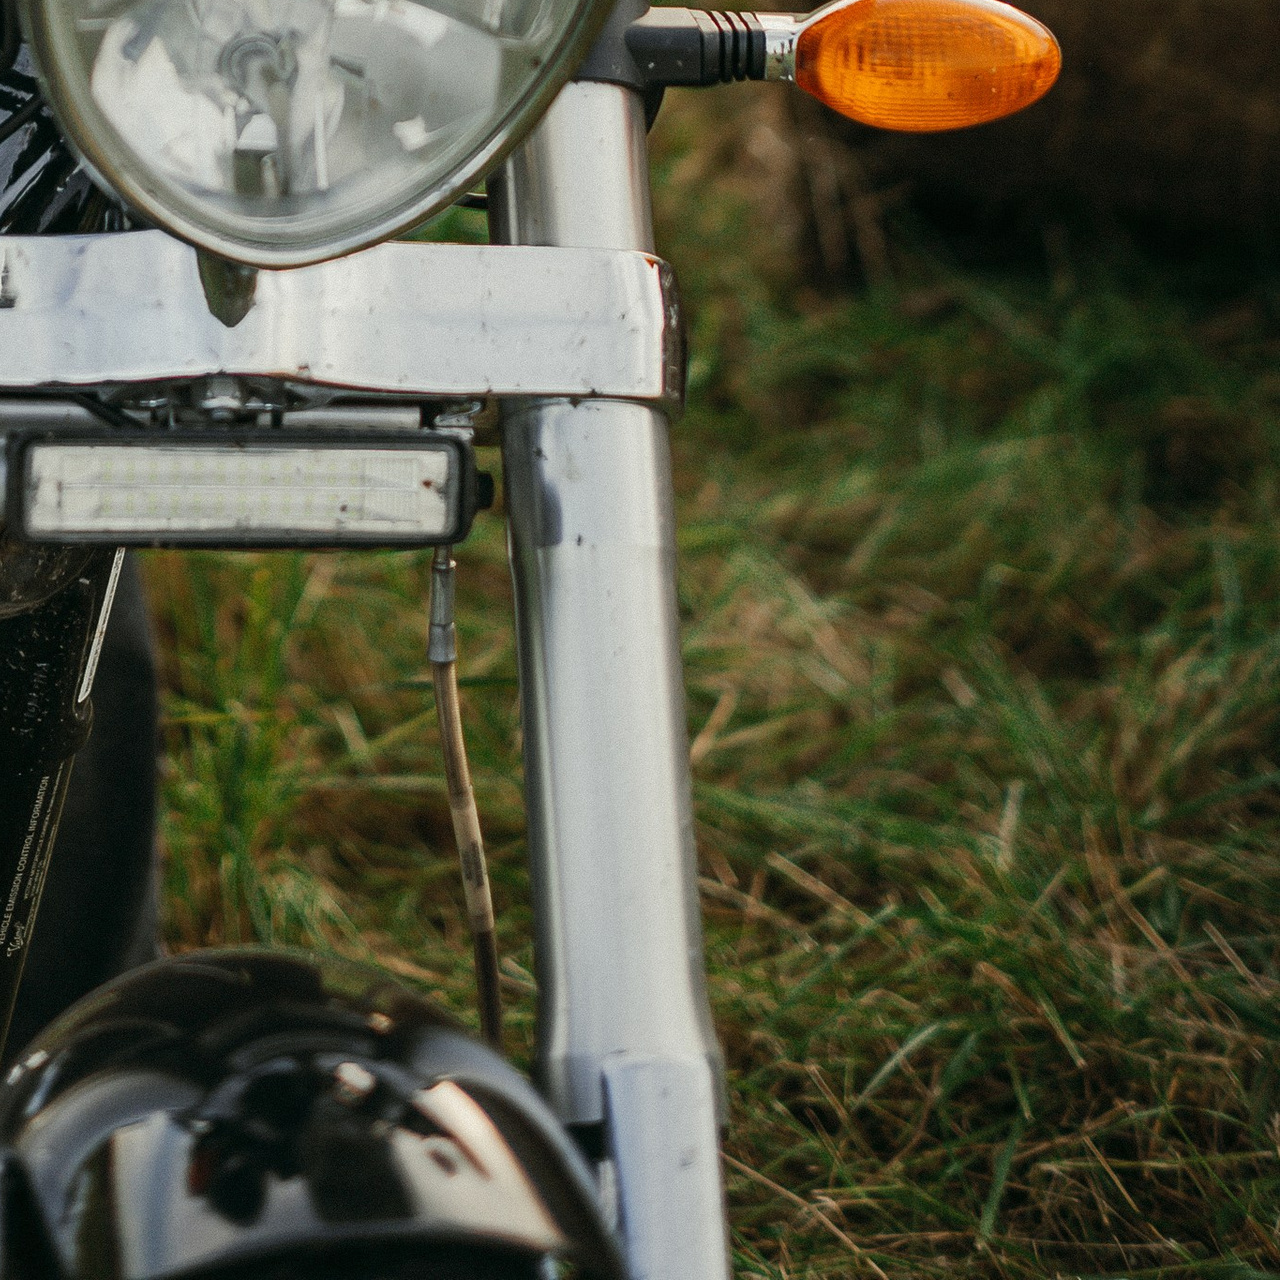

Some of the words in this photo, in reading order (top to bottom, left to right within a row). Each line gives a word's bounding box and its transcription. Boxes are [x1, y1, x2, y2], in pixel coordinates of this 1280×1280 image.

[5, 873, 23, 912] EMISSION
[17, 831, 35, 872] CONTROL
[28, 775, 50, 832] INFORMATION
